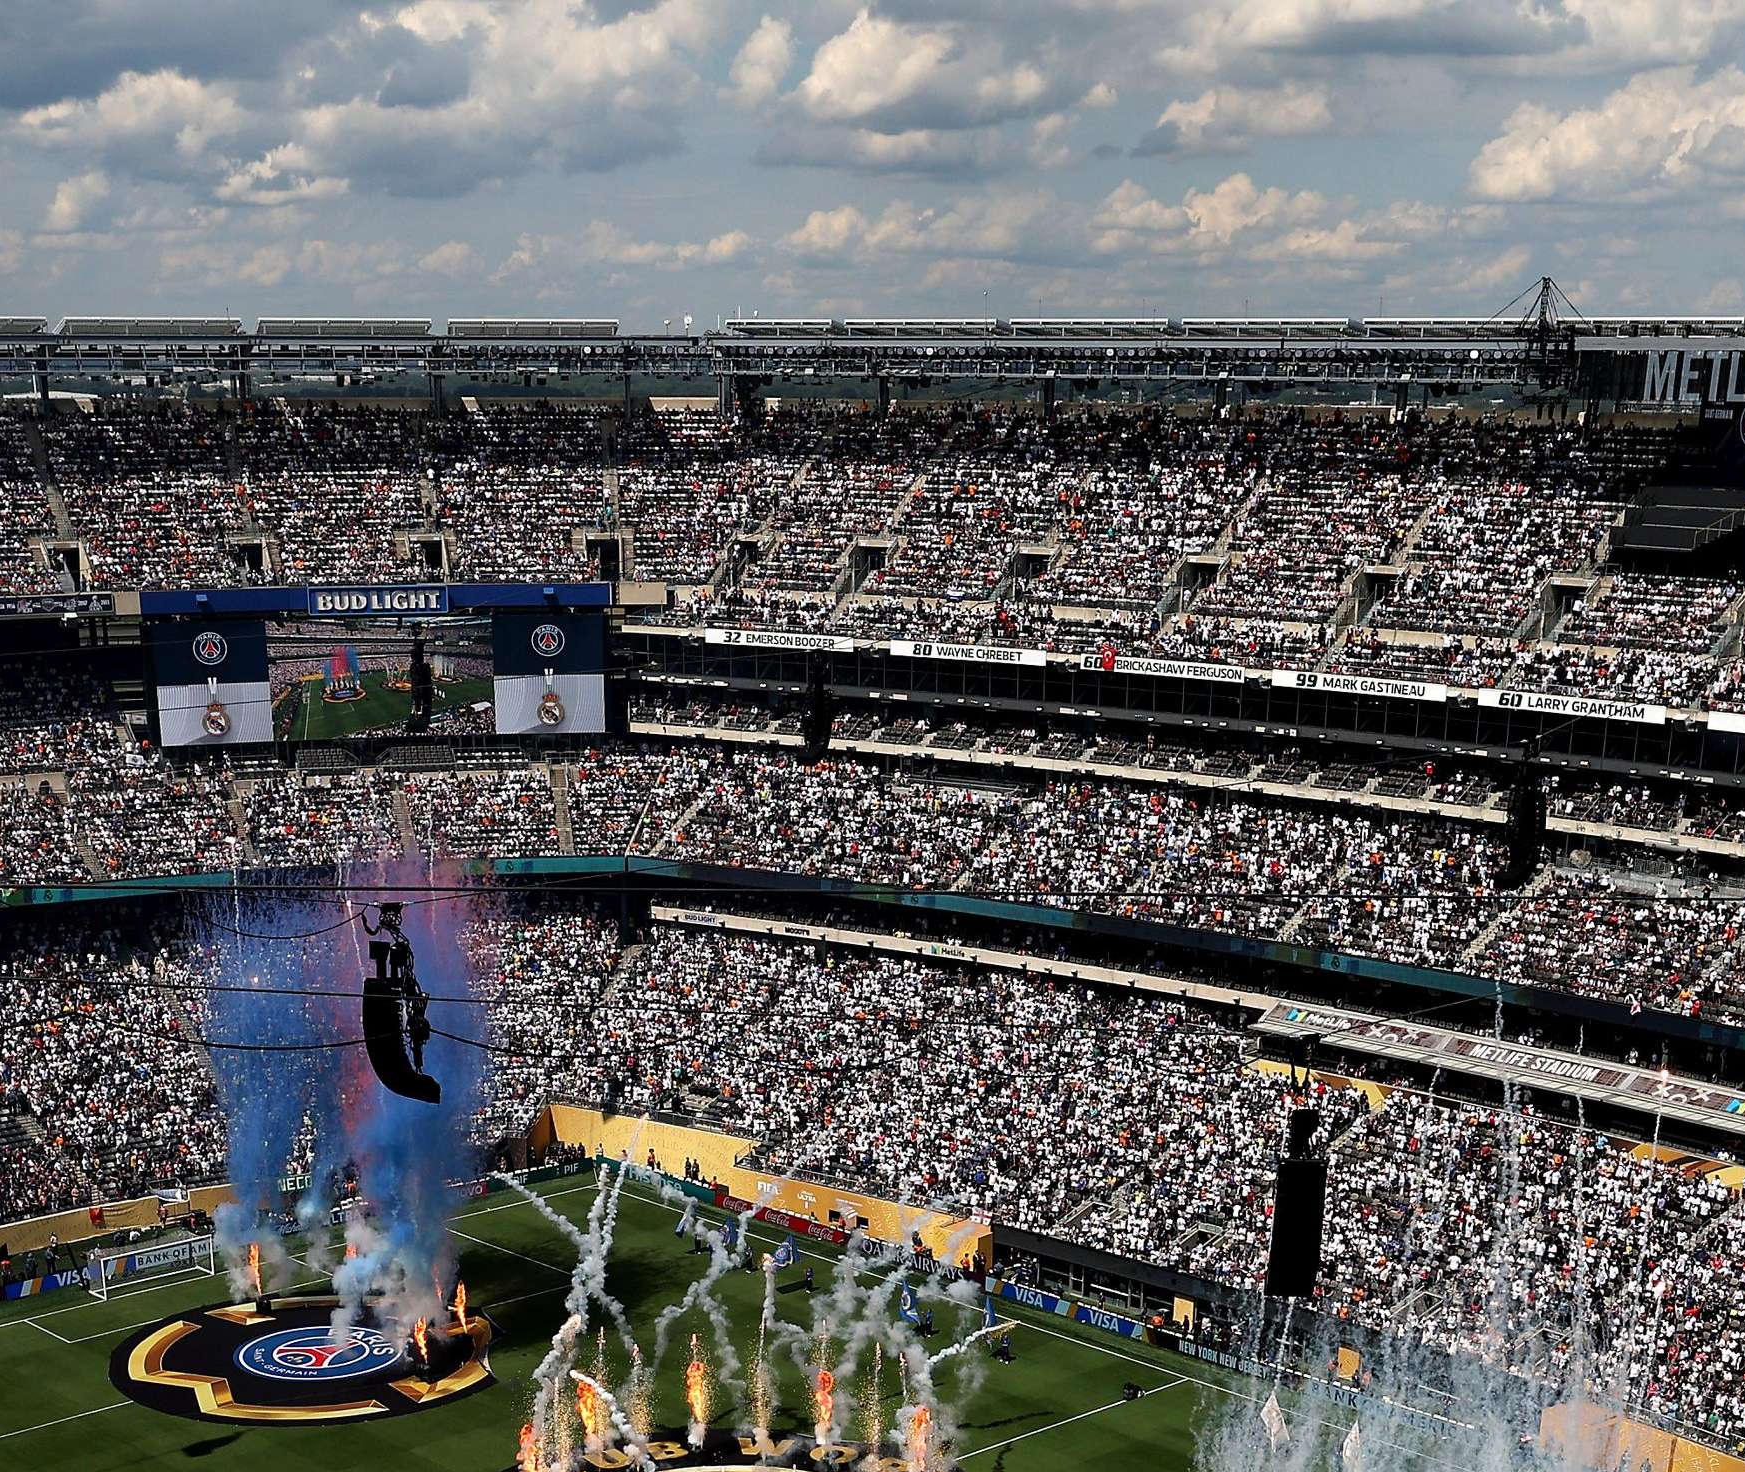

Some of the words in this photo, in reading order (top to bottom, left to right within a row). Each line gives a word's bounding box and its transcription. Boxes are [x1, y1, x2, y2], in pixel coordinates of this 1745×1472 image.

[315, 590, 369, 612] BUD
[370, 588, 439, 611] LIGHT
[723, 631, 741, 644] 32
[746, 633, 793, 647] EMERSON
[795, 635, 835, 649] BOOZER
[913, 643, 932, 657] 80
[937, 646, 975, 659] WAYNE
[976, 647, 1023, 662] CHREBET
[1083, 656, 1103, 670] 60
[1187, 663, 1243, 680] FERGUSON
[1295, 673, 1318, 687] 99
[1322, 677, 1358, 691] MARK
[1360, 680, 1426, 697] GASTINEAU
[1498, 691, 1523, 708] 60
[1527, 695, 1568, 713] LARRY
[1571, 699, 1645, 719] GRANTHAM
[940, 946, 966, 958] MetLife
[1304, 1012, 1352, 1032] MetLife
[1468, 1043, 1532, 1067] METLIFE
[1530, 1057, 1601, 1083] STADIUM
[563, 1163, 579, 1175] PIF
[137, 1253, 169, 1266] BANK
[172, 1247, 187, 1258] OF
[911, 1256, 964, 1280] AIRWAYS
[53, 1265, 92, 1288] VISA
[1013, 1285, 1044, 1309] VISA
[1087, 1309, 1120, 1333] VISA
[253, 1347, 318, 1376] SAINT-GERMAIN
[1178, 1339, 1196, 1356] NEW
[1197, 1345, 1217, 1363] YORK
[1219, 1352, 1237, 1369] NEW
